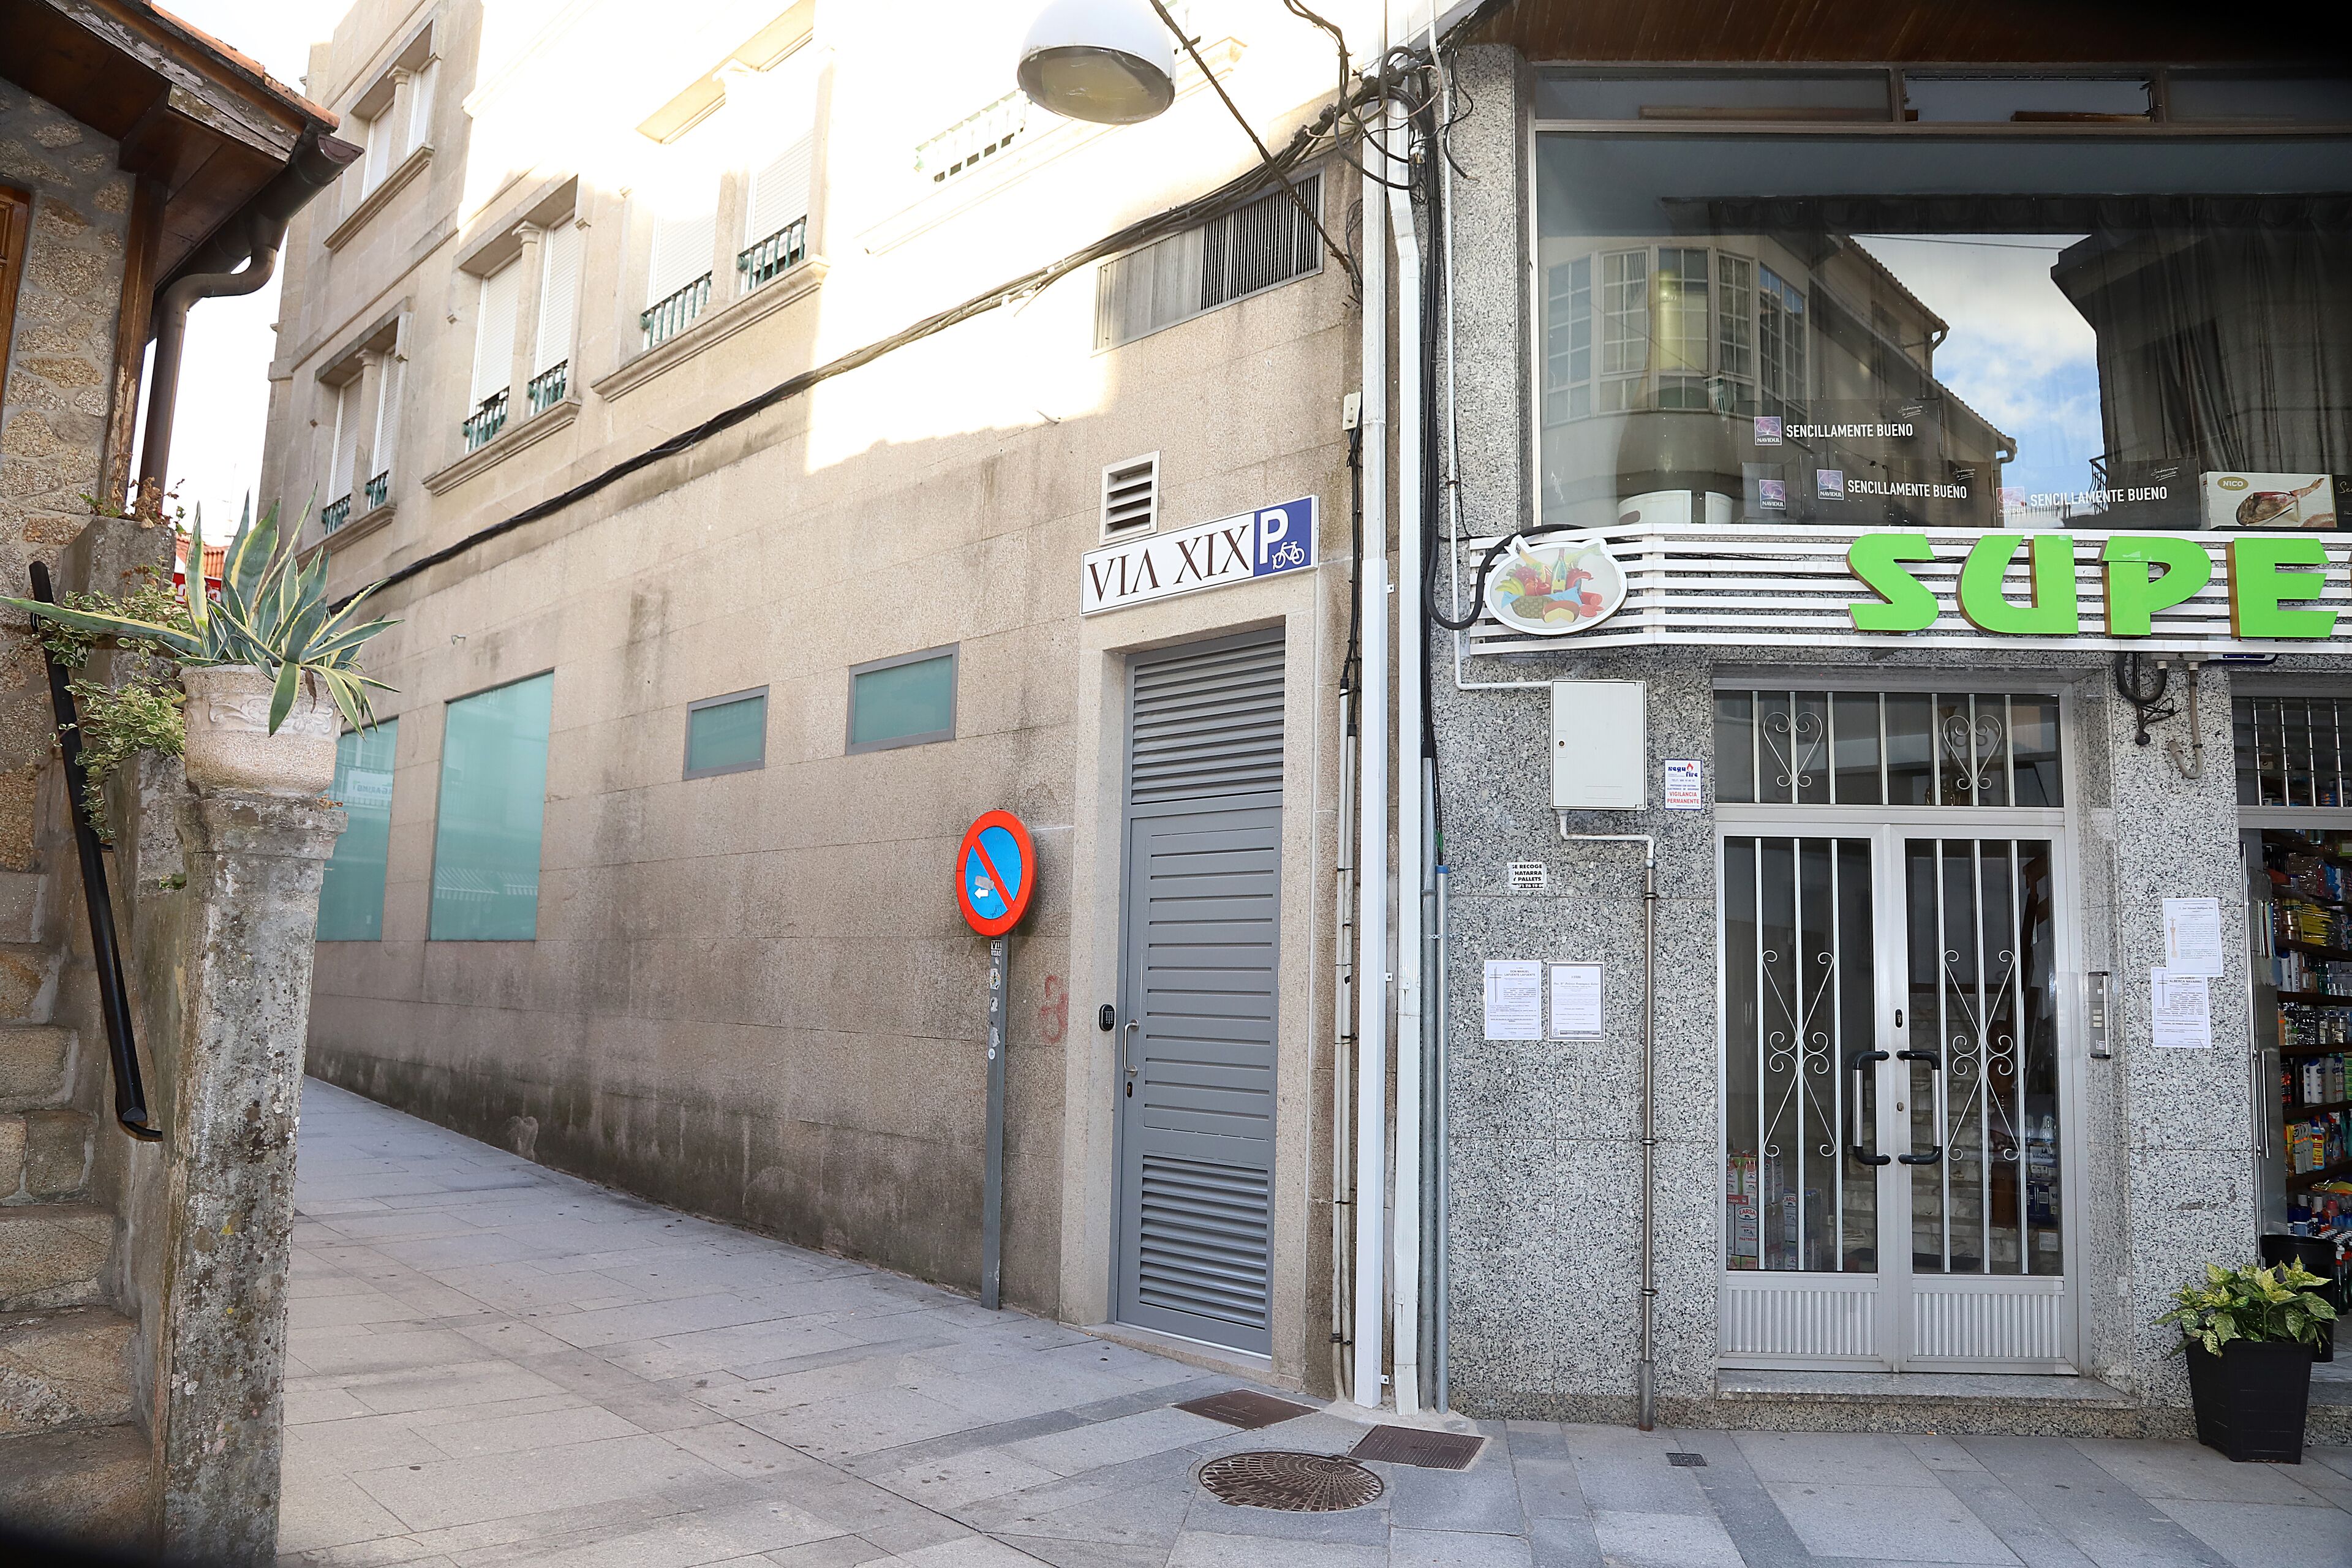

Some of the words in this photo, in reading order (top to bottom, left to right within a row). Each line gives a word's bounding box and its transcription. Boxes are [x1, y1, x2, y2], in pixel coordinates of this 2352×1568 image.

[1786, 424, 1873, 437] SENCILLAMENTE
[1877, 423, 1913, 437] BUENO
[1847, 480, 1929, 497] SENCILLAMENTE
[1933, 484, 1967, 499] BUENO
[2030, 488, 2124, 507] SENCILLAMENTE
[2128, 486, 2168, 501] BUENO
[2339, 481, 2352, 494] Se
[1259, 507, 1289, 565] P
[1087, 548, 1161, 603] VIA
[1172, 524, 1250, 585] XIX
[1846, 532, 2339, 639] SUPE
